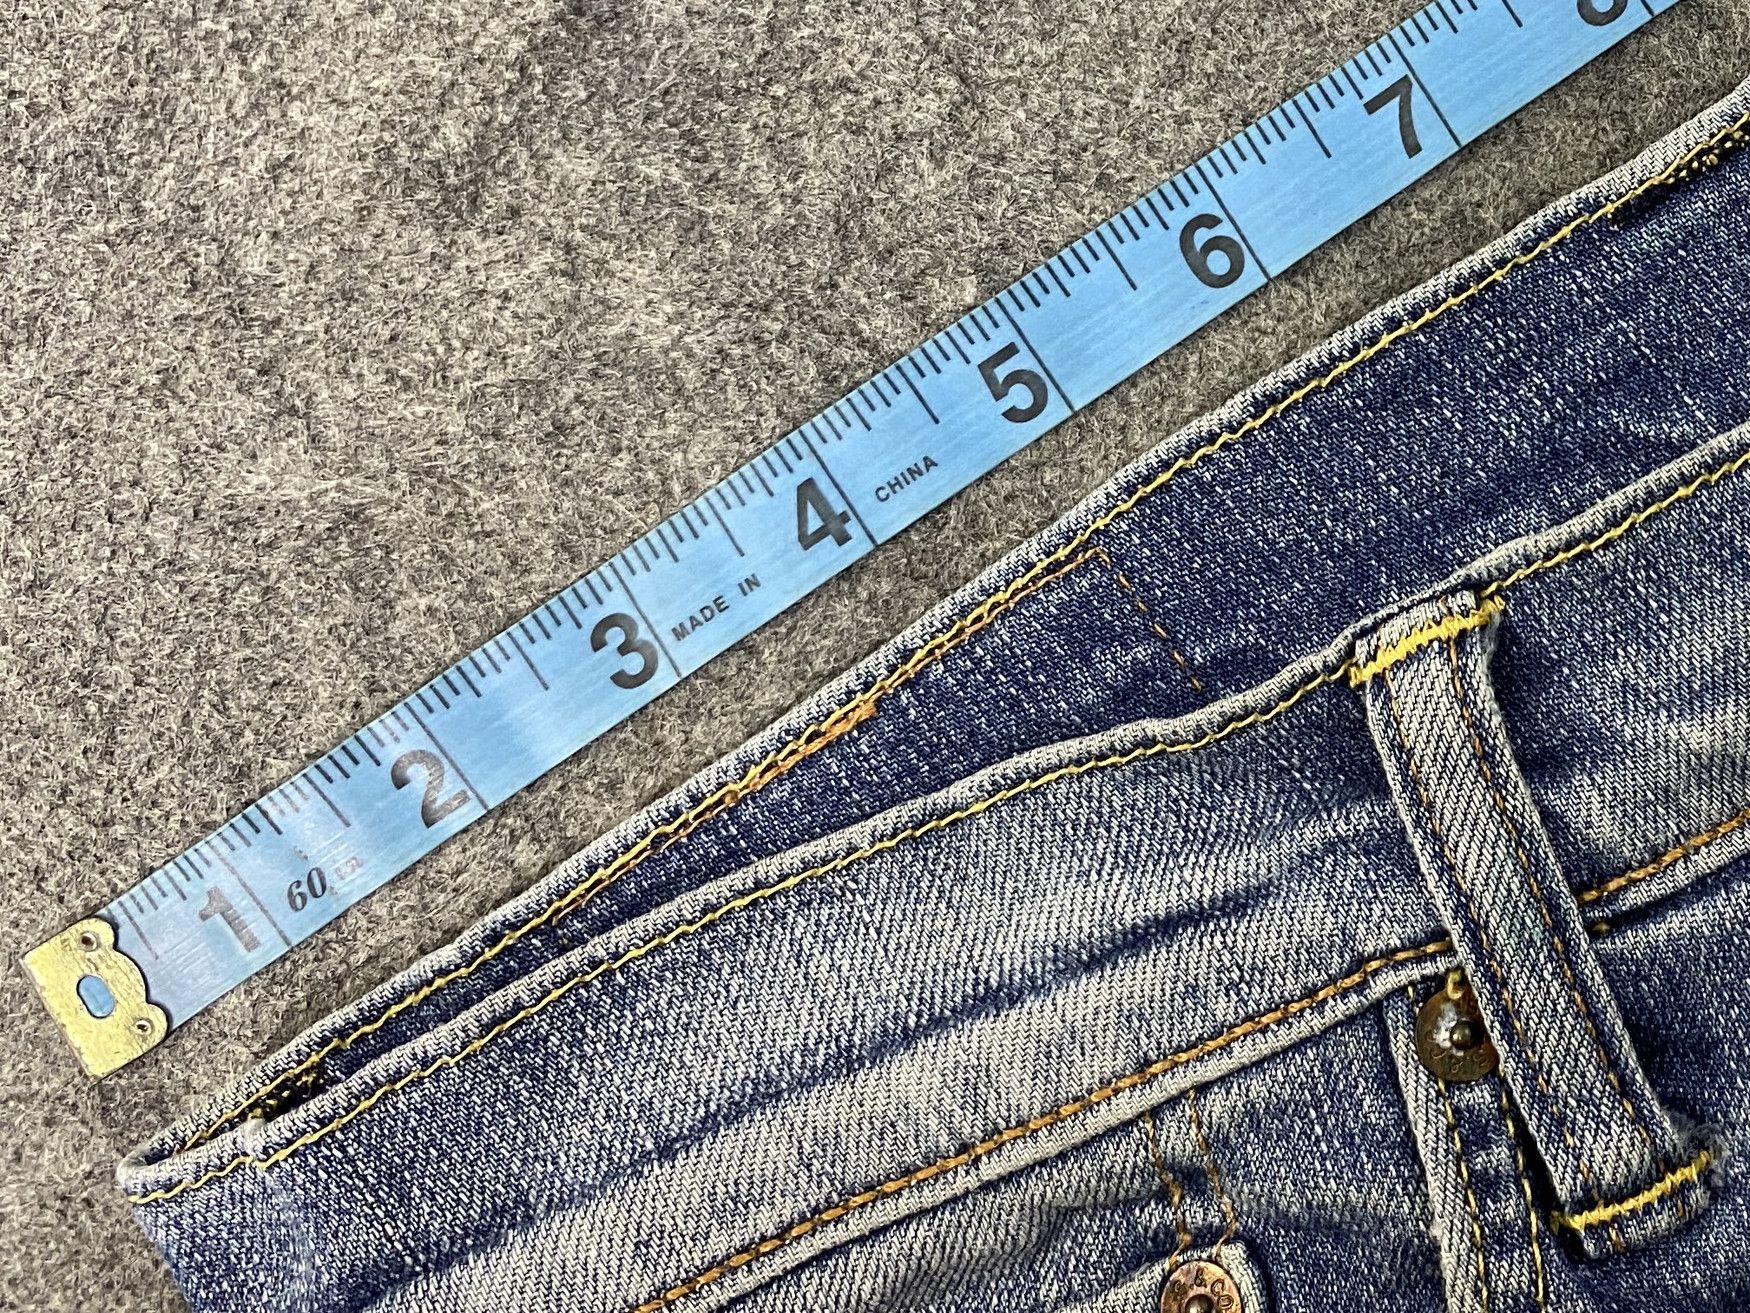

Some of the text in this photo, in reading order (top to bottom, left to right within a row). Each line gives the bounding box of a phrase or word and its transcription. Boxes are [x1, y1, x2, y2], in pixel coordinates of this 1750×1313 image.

[1363, 74, 1424, 159] 7
[1179, 213, 1244, 289] 6
[977, 342, 1049, 423] 5
[671, 454, 938, 642] MADE IN CHINA
[794, 478, 852, 551] 4
[590, 613, 659, 689] 3
[390, 749, 470, 828] 2
[198, 886, 260, 952] 1
[287, 867, 327, 912] 60
